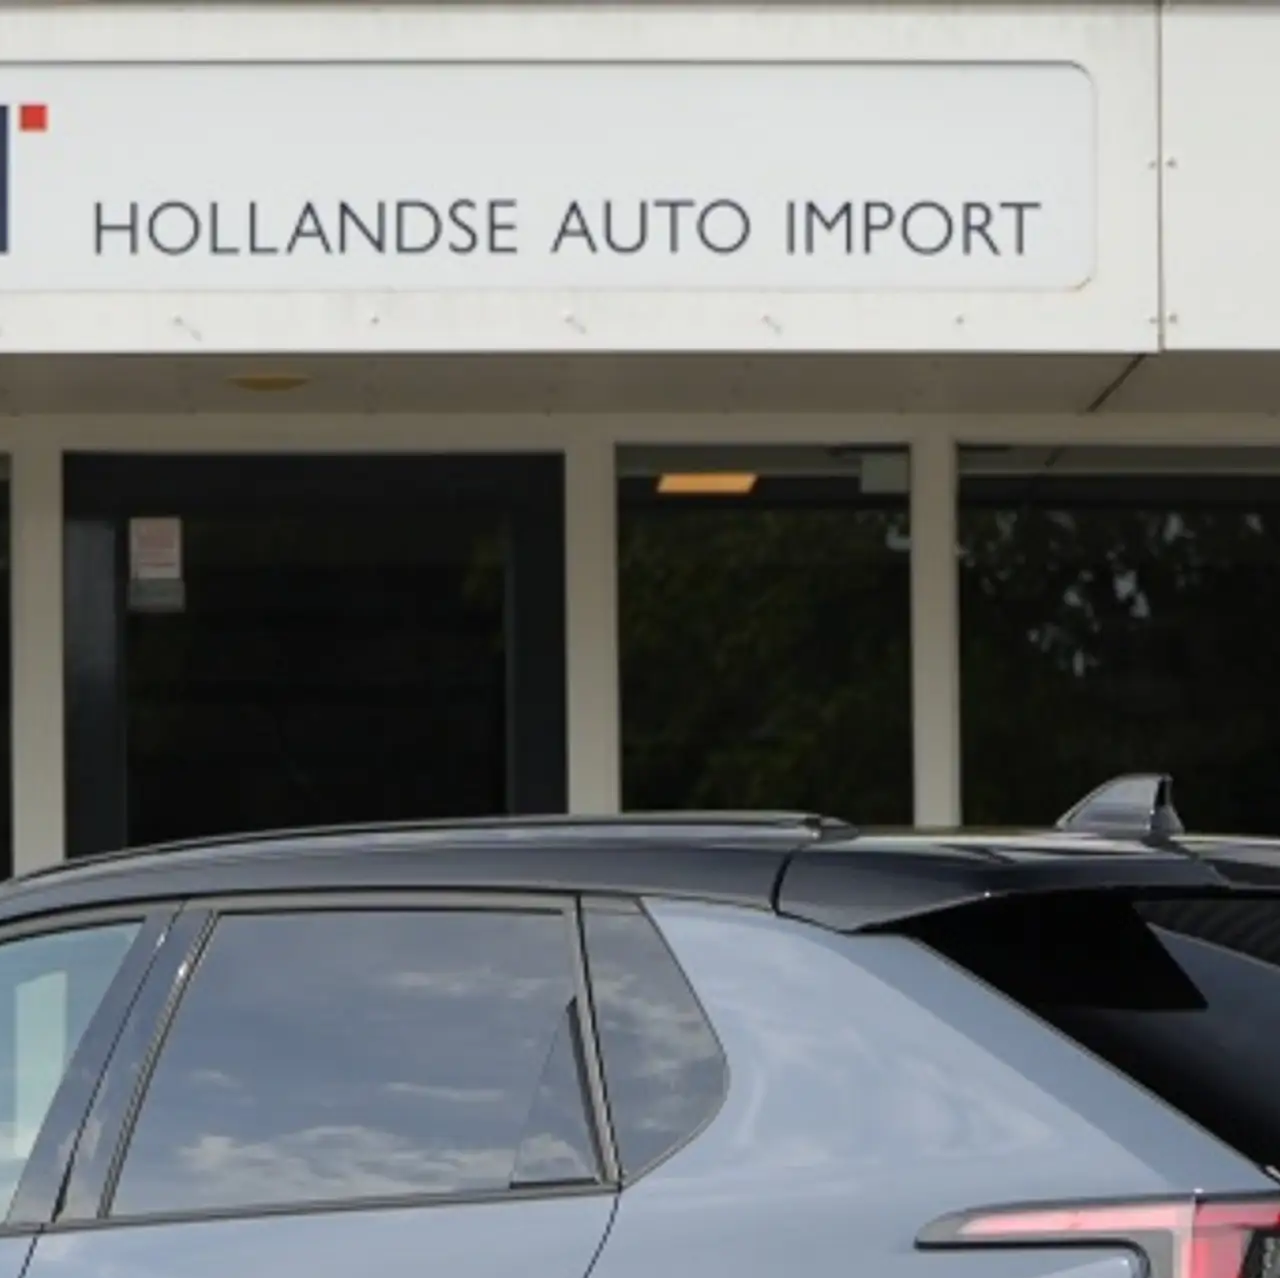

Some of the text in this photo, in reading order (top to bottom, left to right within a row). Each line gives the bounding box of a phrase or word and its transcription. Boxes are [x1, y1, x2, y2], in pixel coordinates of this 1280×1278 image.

[96, 199, 1041, 255] HOLLANDSE AUTO IMPORT
